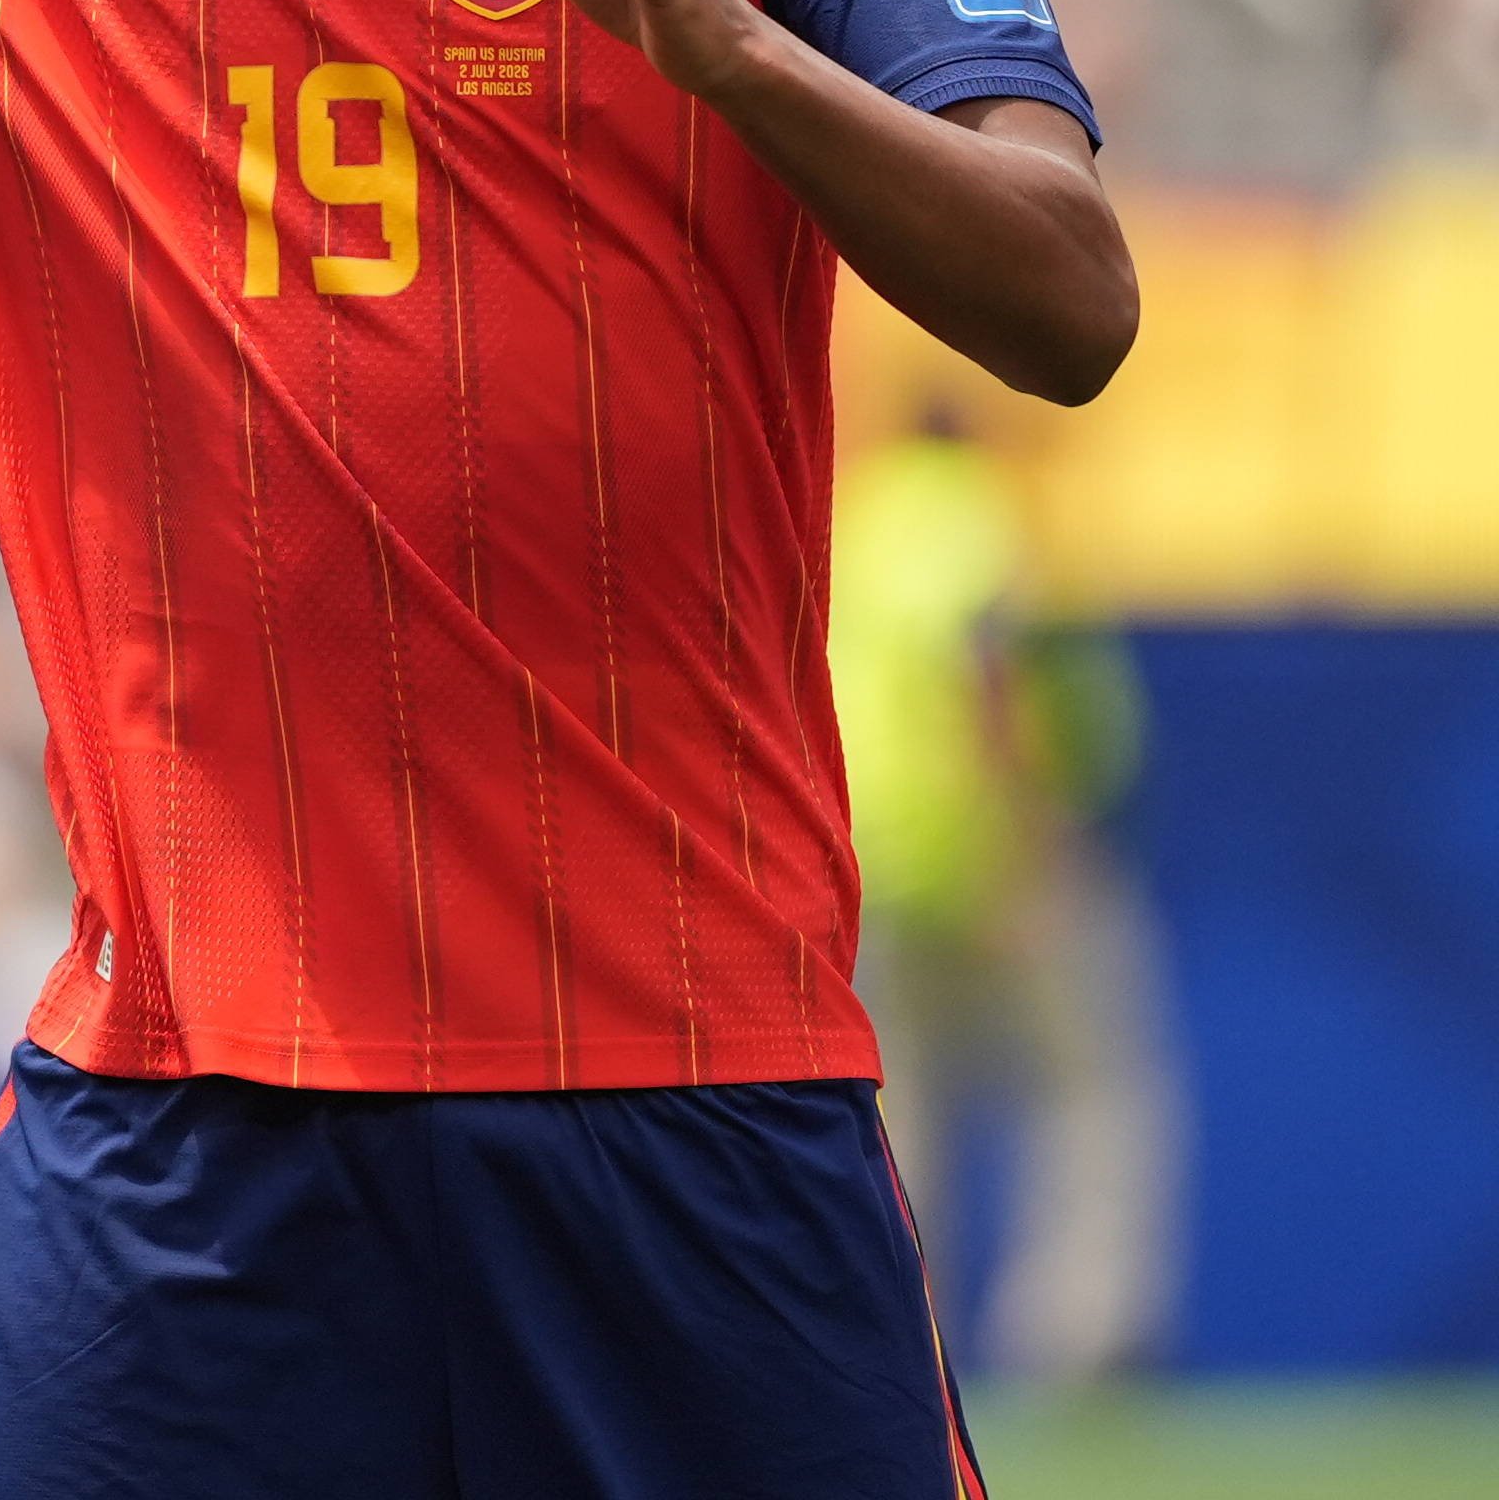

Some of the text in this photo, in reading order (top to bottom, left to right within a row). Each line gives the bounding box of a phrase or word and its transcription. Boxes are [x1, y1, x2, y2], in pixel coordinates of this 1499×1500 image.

[444, 47, 476, 61] SPAIN
[498, 47, 545, 61] AUSTRIA
[459, 64, 530, 79] 2 JULY 2026
[456, 81, 532, 96] LOS ANGELES
[226, 61, 421, 298] 19
